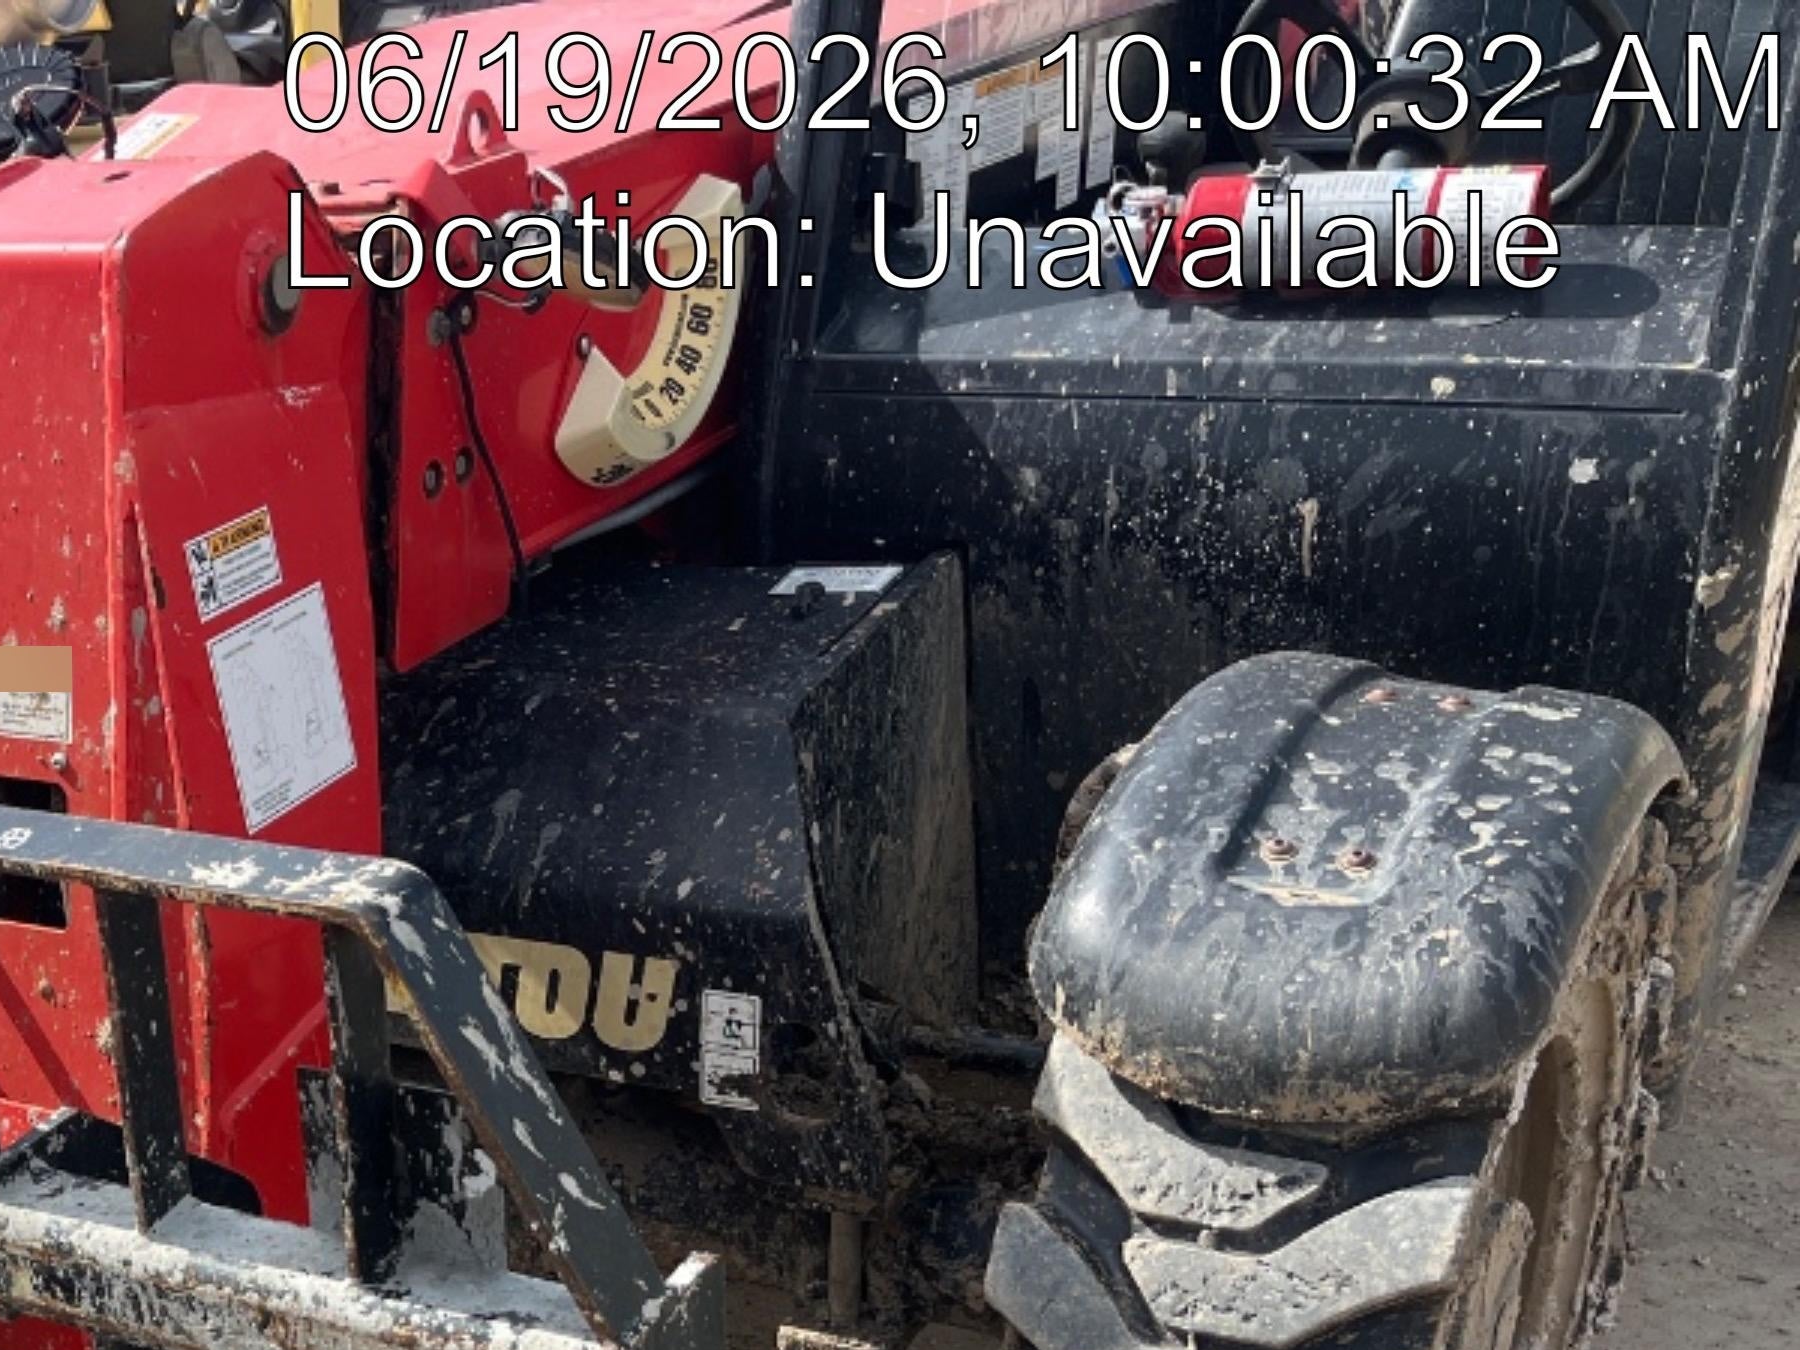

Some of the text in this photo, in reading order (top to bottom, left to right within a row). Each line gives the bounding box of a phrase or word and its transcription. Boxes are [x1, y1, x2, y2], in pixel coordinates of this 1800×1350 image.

[687, 302, 715, 337] 60
[675, 344, 704, 376] 40
[659, 377, 687, 405] 20
